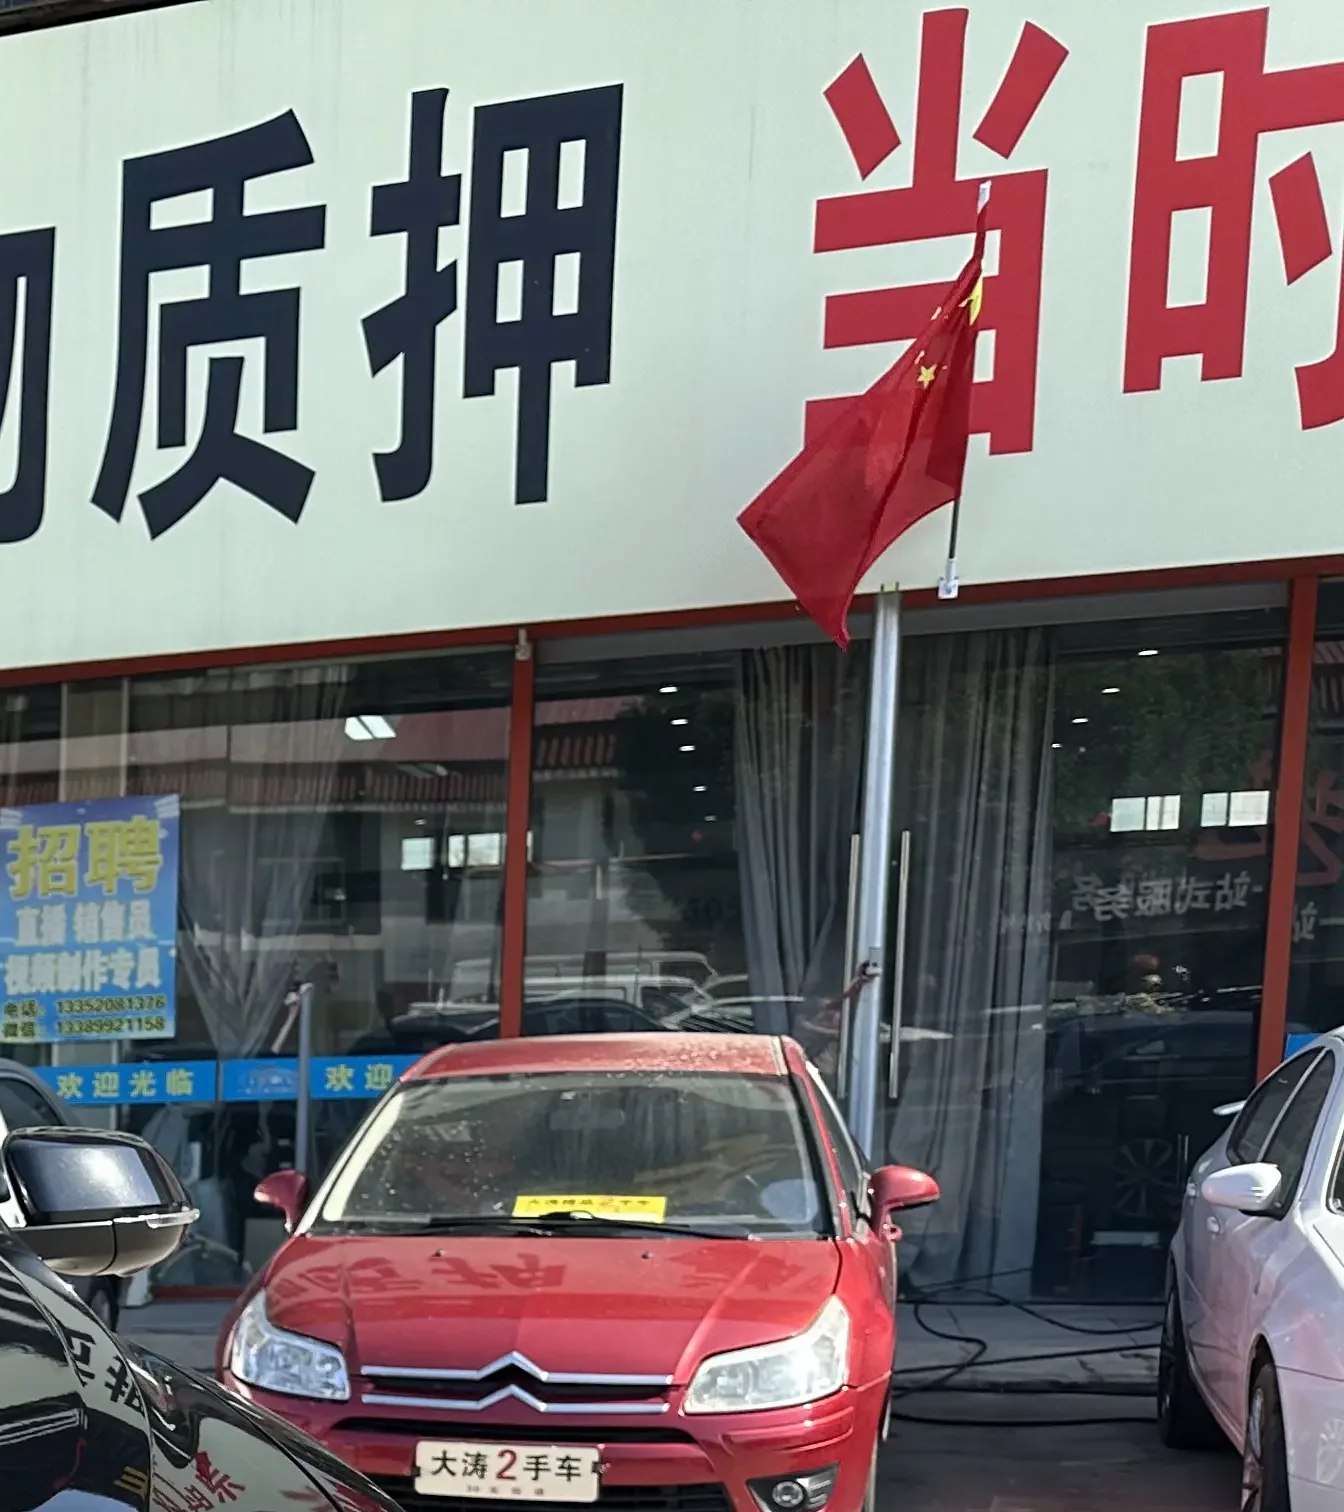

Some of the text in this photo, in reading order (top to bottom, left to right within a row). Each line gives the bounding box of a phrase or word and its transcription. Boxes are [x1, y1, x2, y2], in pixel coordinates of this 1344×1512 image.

[6, 815, 163, 899] 招聘
[56, 1068, 195, 1099] 欢迎光临
[324, 1063, 394, 1093] 欢迎
[431, 1449, 581, 1482] 大涛2手车
